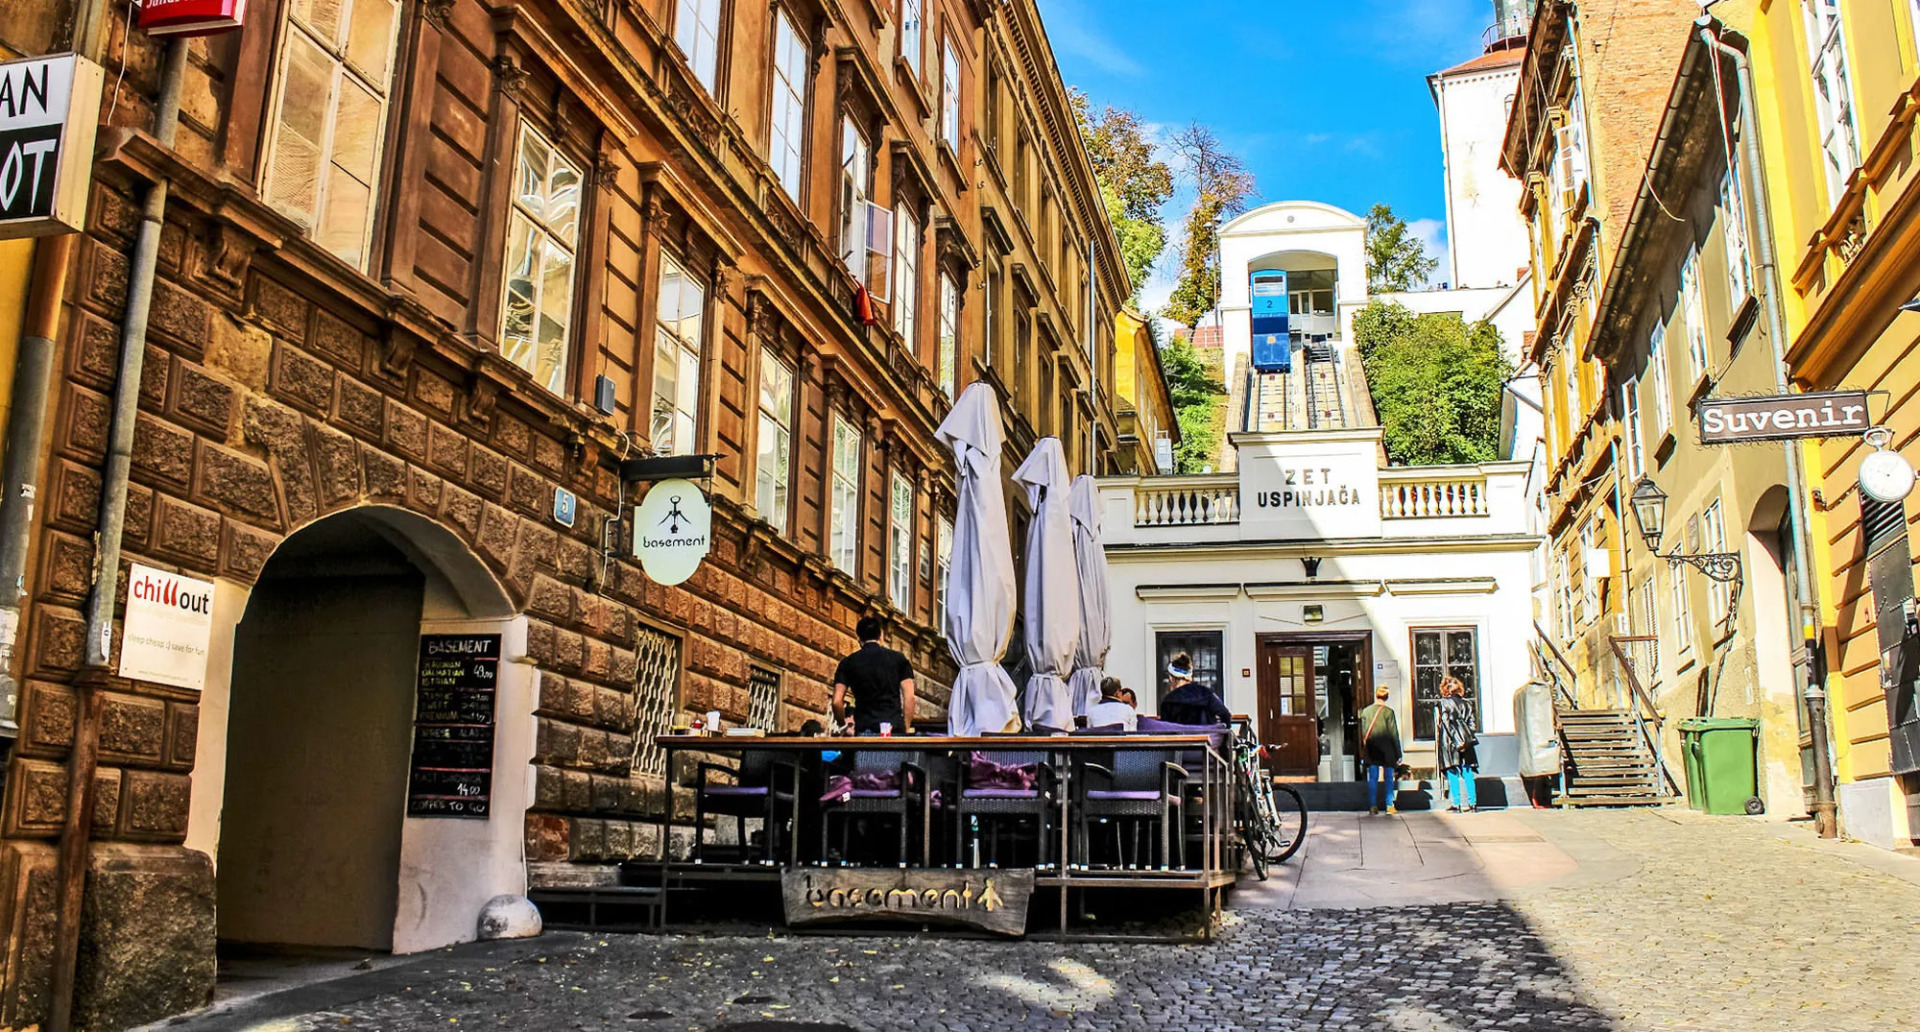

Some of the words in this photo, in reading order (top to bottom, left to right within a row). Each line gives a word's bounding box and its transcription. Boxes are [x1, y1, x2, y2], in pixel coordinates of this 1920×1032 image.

[1267, 300, 1273, 309] 2
[1703, 401, 1863, 433] Suvenir
[1285, 468, 1331, 486] ZET
[561, 493, 569, 514] 5
[1258, 484, 1361, 508] USPINJAČA
[643, 535, 705, 548] basement
[134, 576, 209, 615] chillout
[428, 639, 491, 654] BASEMENT
[449, 801, 464, 811] TO
[804, 875, 971, 909] basement
